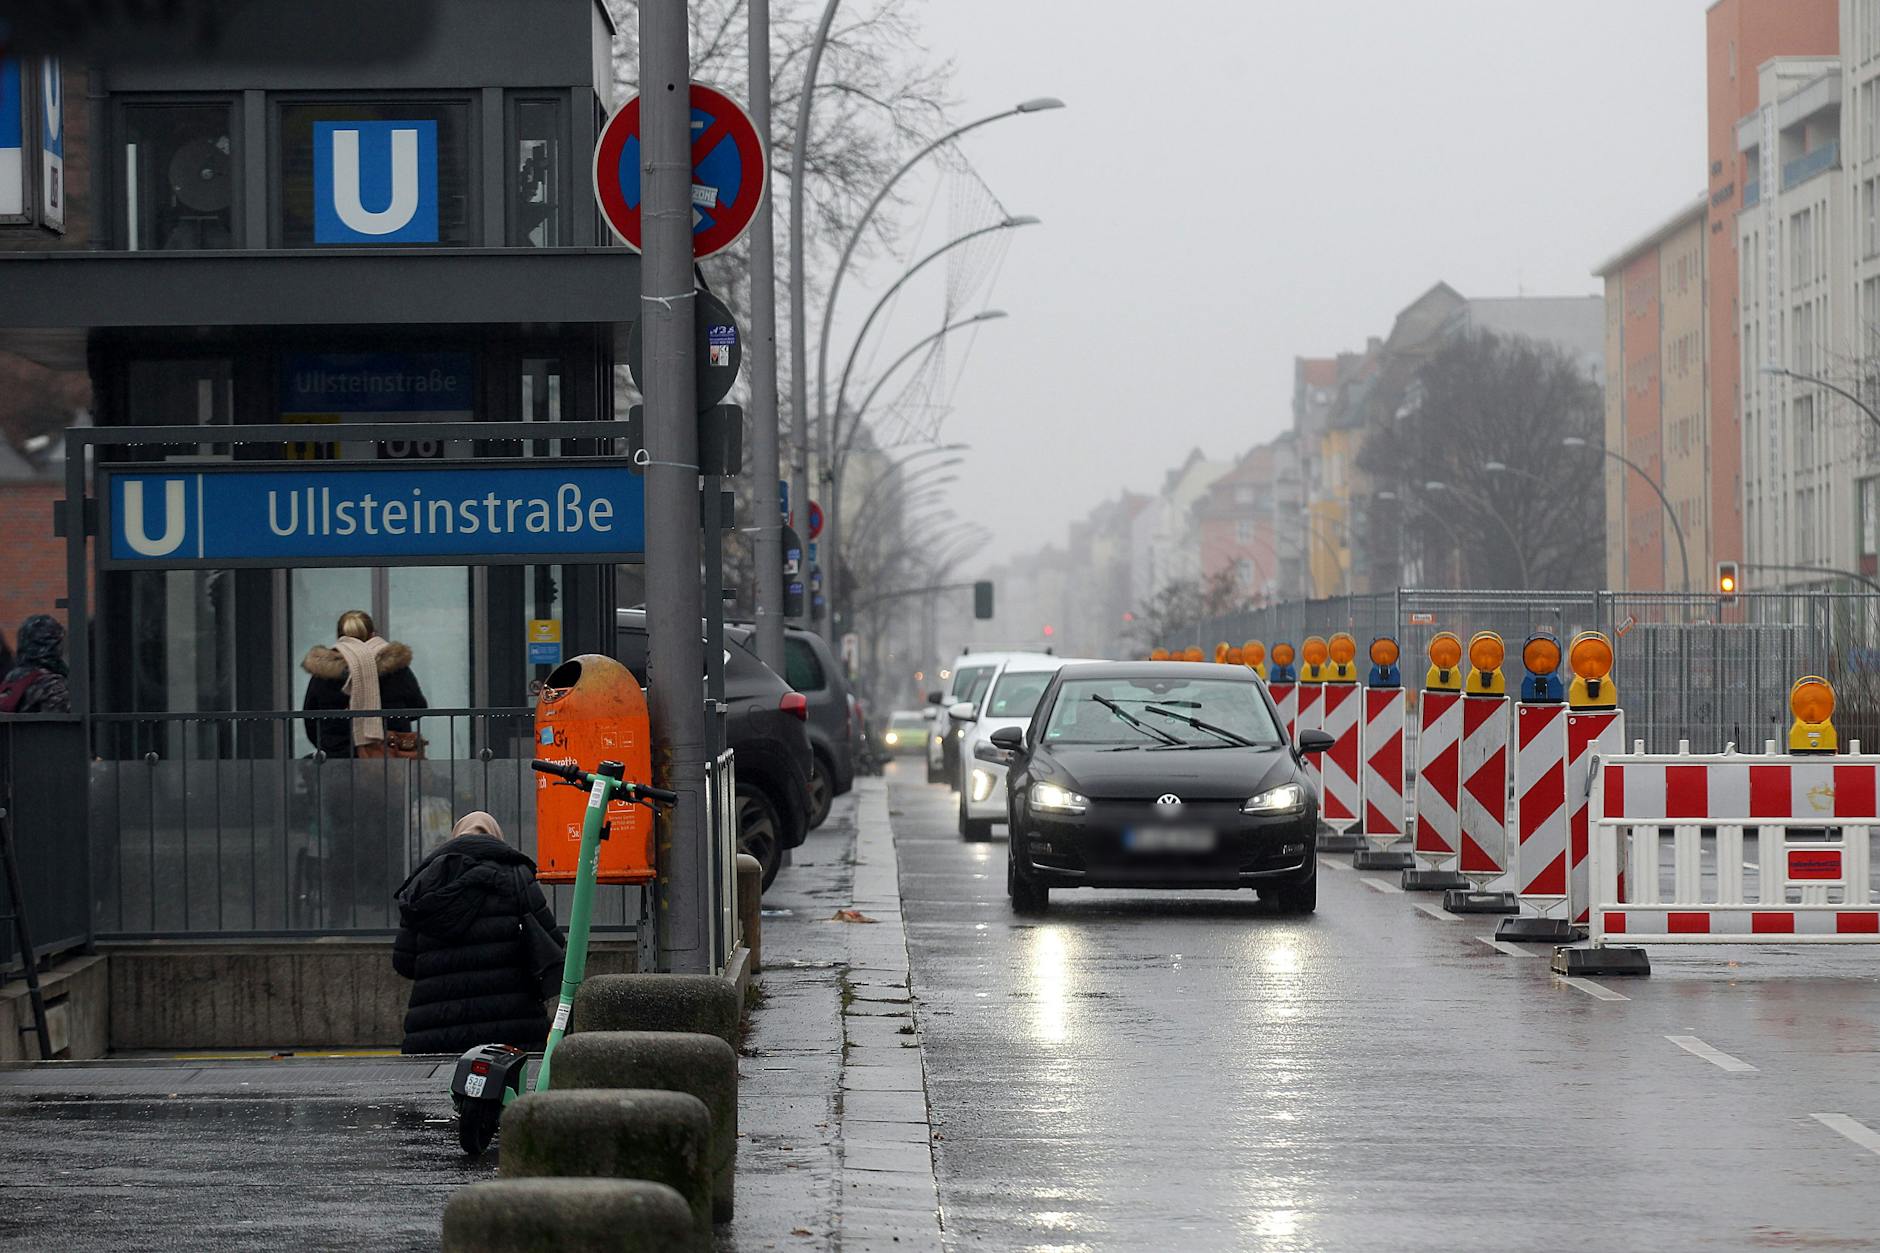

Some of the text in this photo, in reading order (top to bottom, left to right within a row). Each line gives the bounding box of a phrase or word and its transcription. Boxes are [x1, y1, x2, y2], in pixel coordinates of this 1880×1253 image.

[333, 130, 419, 235] U
[295, 369, 457, 393] Ullsteinstraße
[124, 480, 613, 557] U Ullsteinstraße
